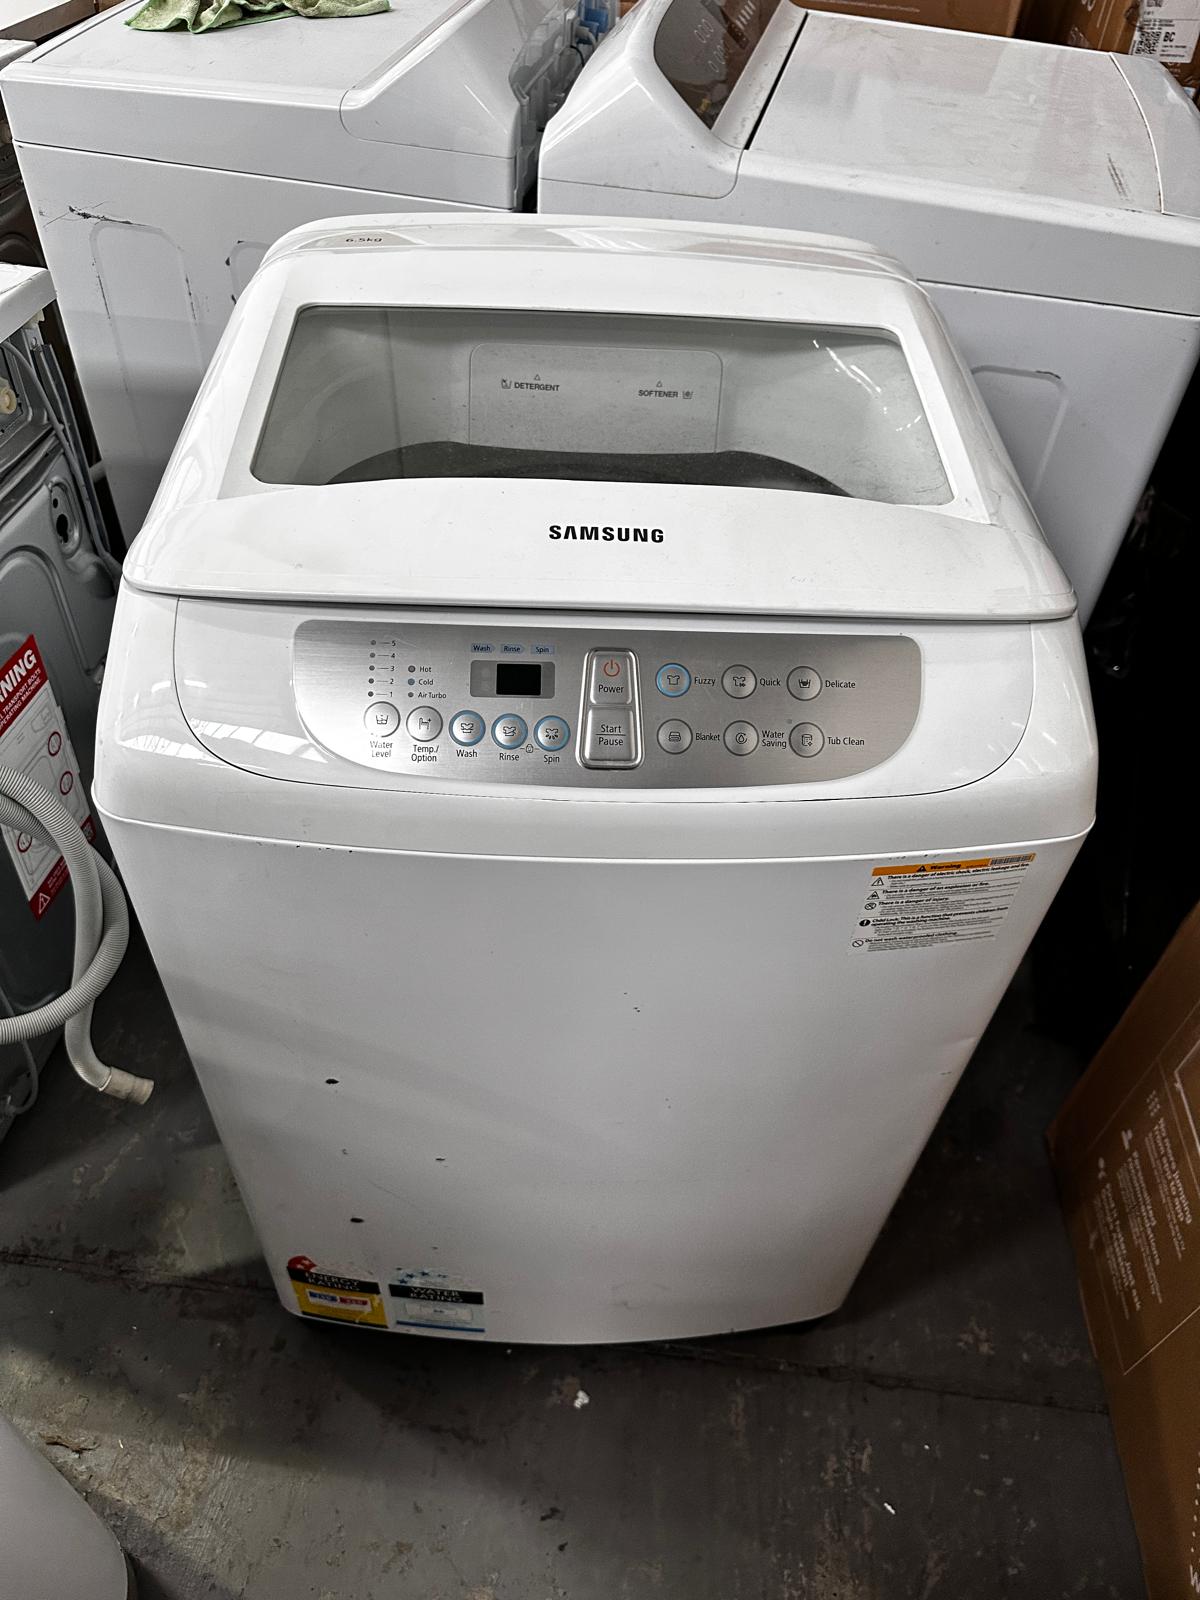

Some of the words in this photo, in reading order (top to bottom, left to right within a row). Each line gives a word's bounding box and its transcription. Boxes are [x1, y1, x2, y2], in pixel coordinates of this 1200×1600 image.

[1163, 31, 1176, 42] BC
[514, 382, 560, 392] DETERGENT
[638, 389, 679, 399] SOFTENER
[548, 525, 664, 543] SAMSUNG
[535, 646, 550, 654] Spin
[390, 652, 396, 660] 4
[418, 678, 434, 686] Cold
[694, 676, 716, 687] Fuzzy
[759, 678, 781, 687] Quick
[825, 679, 856, 689] Delicate
[598, 684, 624, 694] Power
[428, 692, 447, 700] Turbo
[600, 724, 622, 733] Start
[695, 733, 721, 742] Blanket
[762, 730, 785, 739] Water
[370, 741, 393, 749] Water
[598, 736, 624, 746] Pause
[761, 739, 787, 749] Saving
[827, 737, 842, 746] Tub
[843, 737, 865, 746] Clean
[371, 750, 392, 758] Level
[412, 744, 440, 756] Temp./
[456, 749, 478, 758] Wash
[411, 754, 438, 763] Option
[499, 752, 520, 761] Rinse
[543, 754, 560, 764] Spin
[1172, 1169, 1192, 1225] jumping
